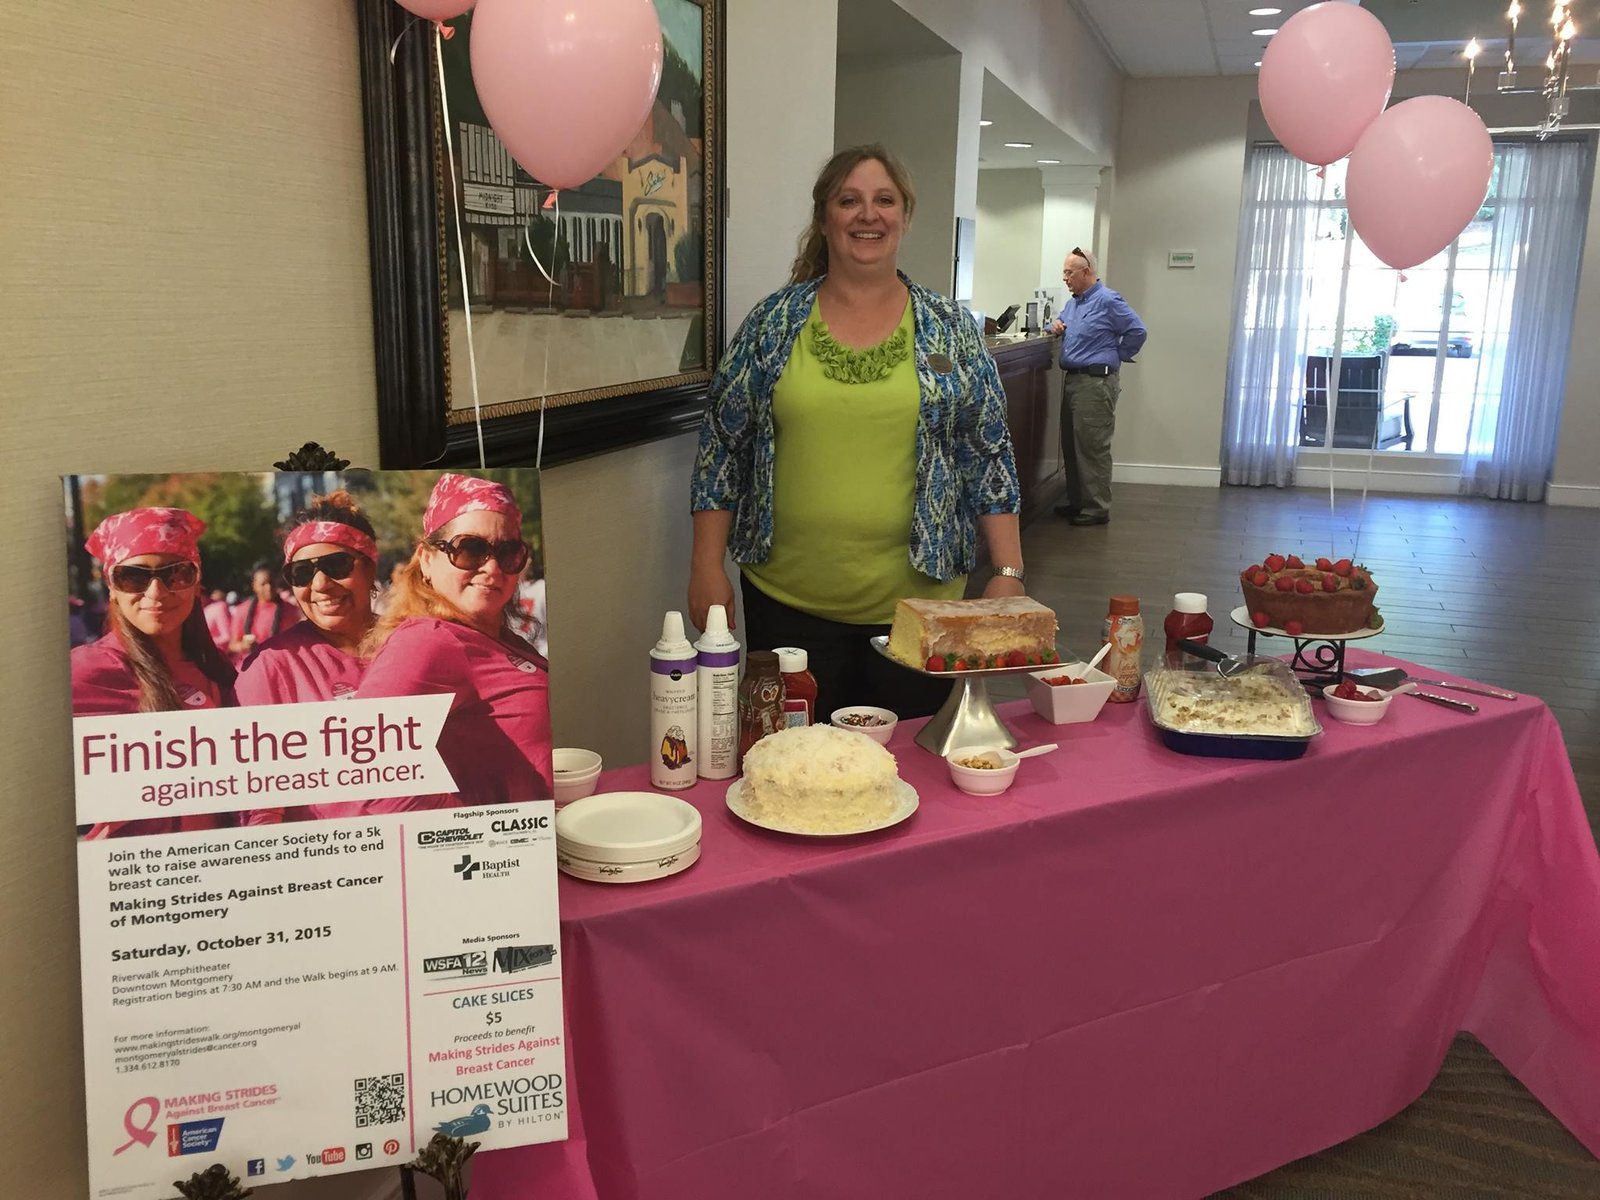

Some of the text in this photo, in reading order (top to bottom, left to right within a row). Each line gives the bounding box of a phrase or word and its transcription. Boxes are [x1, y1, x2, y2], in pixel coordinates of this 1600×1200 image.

[82, 712, 422, 776] Finish the fight
[140, 763, 425, 807] against breast cancer.
[453, 808, 519, 820] Flagship Sponsors
[435, 827, 470, 837] CAPITOL
[491, 816, 549, 833] CLASSIC
[108, 826, 381, 863] Join the American Cancer Society for a 5k
[436, 832, 484, 844] CHEVROLET
[108, 839, 385, 877] walk to raise awareness and funds to end
[482, 858, 521, 875] Baptist
[109, 874, 202, 892] breast cancer.
[482, 871, 511, 879] HEALTH
[109, 874, 384, 914] Making Strides Against Breast Cancer
[110, 907, 229, 928] of Montgomery
[111, 925, 333, 962] Saturday, October 31, 2015
[462, 932, 520, 945] Media Sponsors
[425, 951, 486, 971] WSFA 12
[463, 967, 488, 975] News
[112, 962, 231, 984] Riverwalk Amphitheater
[112, 973, 234, 995] Downtown Montgomery
[112, 964, 399, 1007] Registration begins at 7:30 AM and the Walk begins at 9 AM.
[452, 988, 534, 1009] CAKE SLICES
[485, 1011, 503, 1026] $5
[114, 1035, 128, 1043] For
[131, 1033, 154, 1042] more
[454, 1025, 536, 1043] Proceeds to benefit
[428, 1036, 561, 1063] Making Strides Against
[456, 1056, 536, 1076] Breast Cancer
[164, 1084, 278, 1109] MAKING STRIDES
[431, 1074, 563, 1107] HOMEWOOD
[165, 1104, 206, 1120] Against
[207, 1100, 241, 1113] Breast
[497, 1091, 564, 1116] SUITES
[498, 1112, 561, 1129] BY HILTON
[182, 1127, 217, 1137] American
[182, 1133, 208, 1143] Cancer
[182, 1139, 209, 1150] Society
[306, 1147, 345, 1165] YouTube
